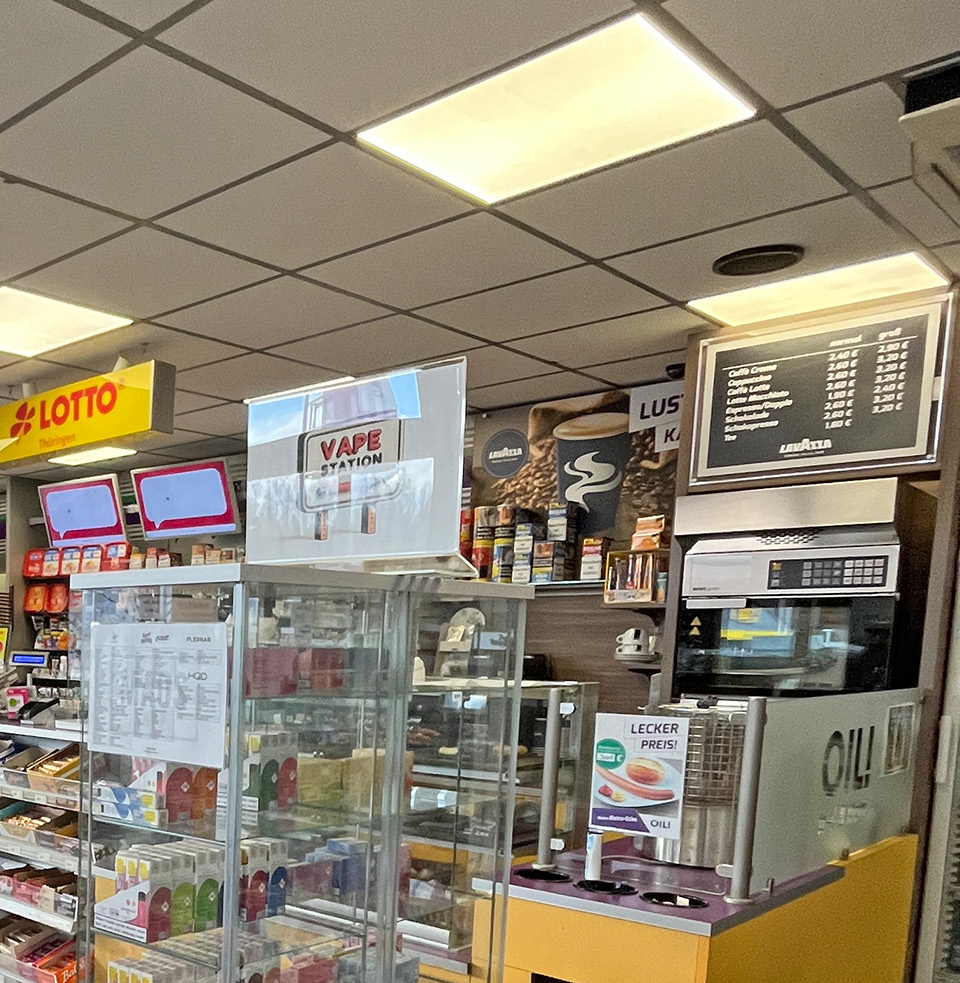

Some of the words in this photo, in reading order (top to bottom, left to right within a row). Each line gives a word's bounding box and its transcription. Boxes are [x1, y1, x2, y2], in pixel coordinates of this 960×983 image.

[40, 382, 117, 429] LOTTO
[640, 394, 684, 419] LUS
[321, 429, 382, 461] VAPE
[780, 438, 832, 453] LAVAZZA
[320, 452, 382, 476] STATION
[631, 723, 678, 734] LECKER
[641, 740, 677, 749] PREIS!
[822, 726, 874, 796] OIL!
[650, 820, 670, 829] OIL!
